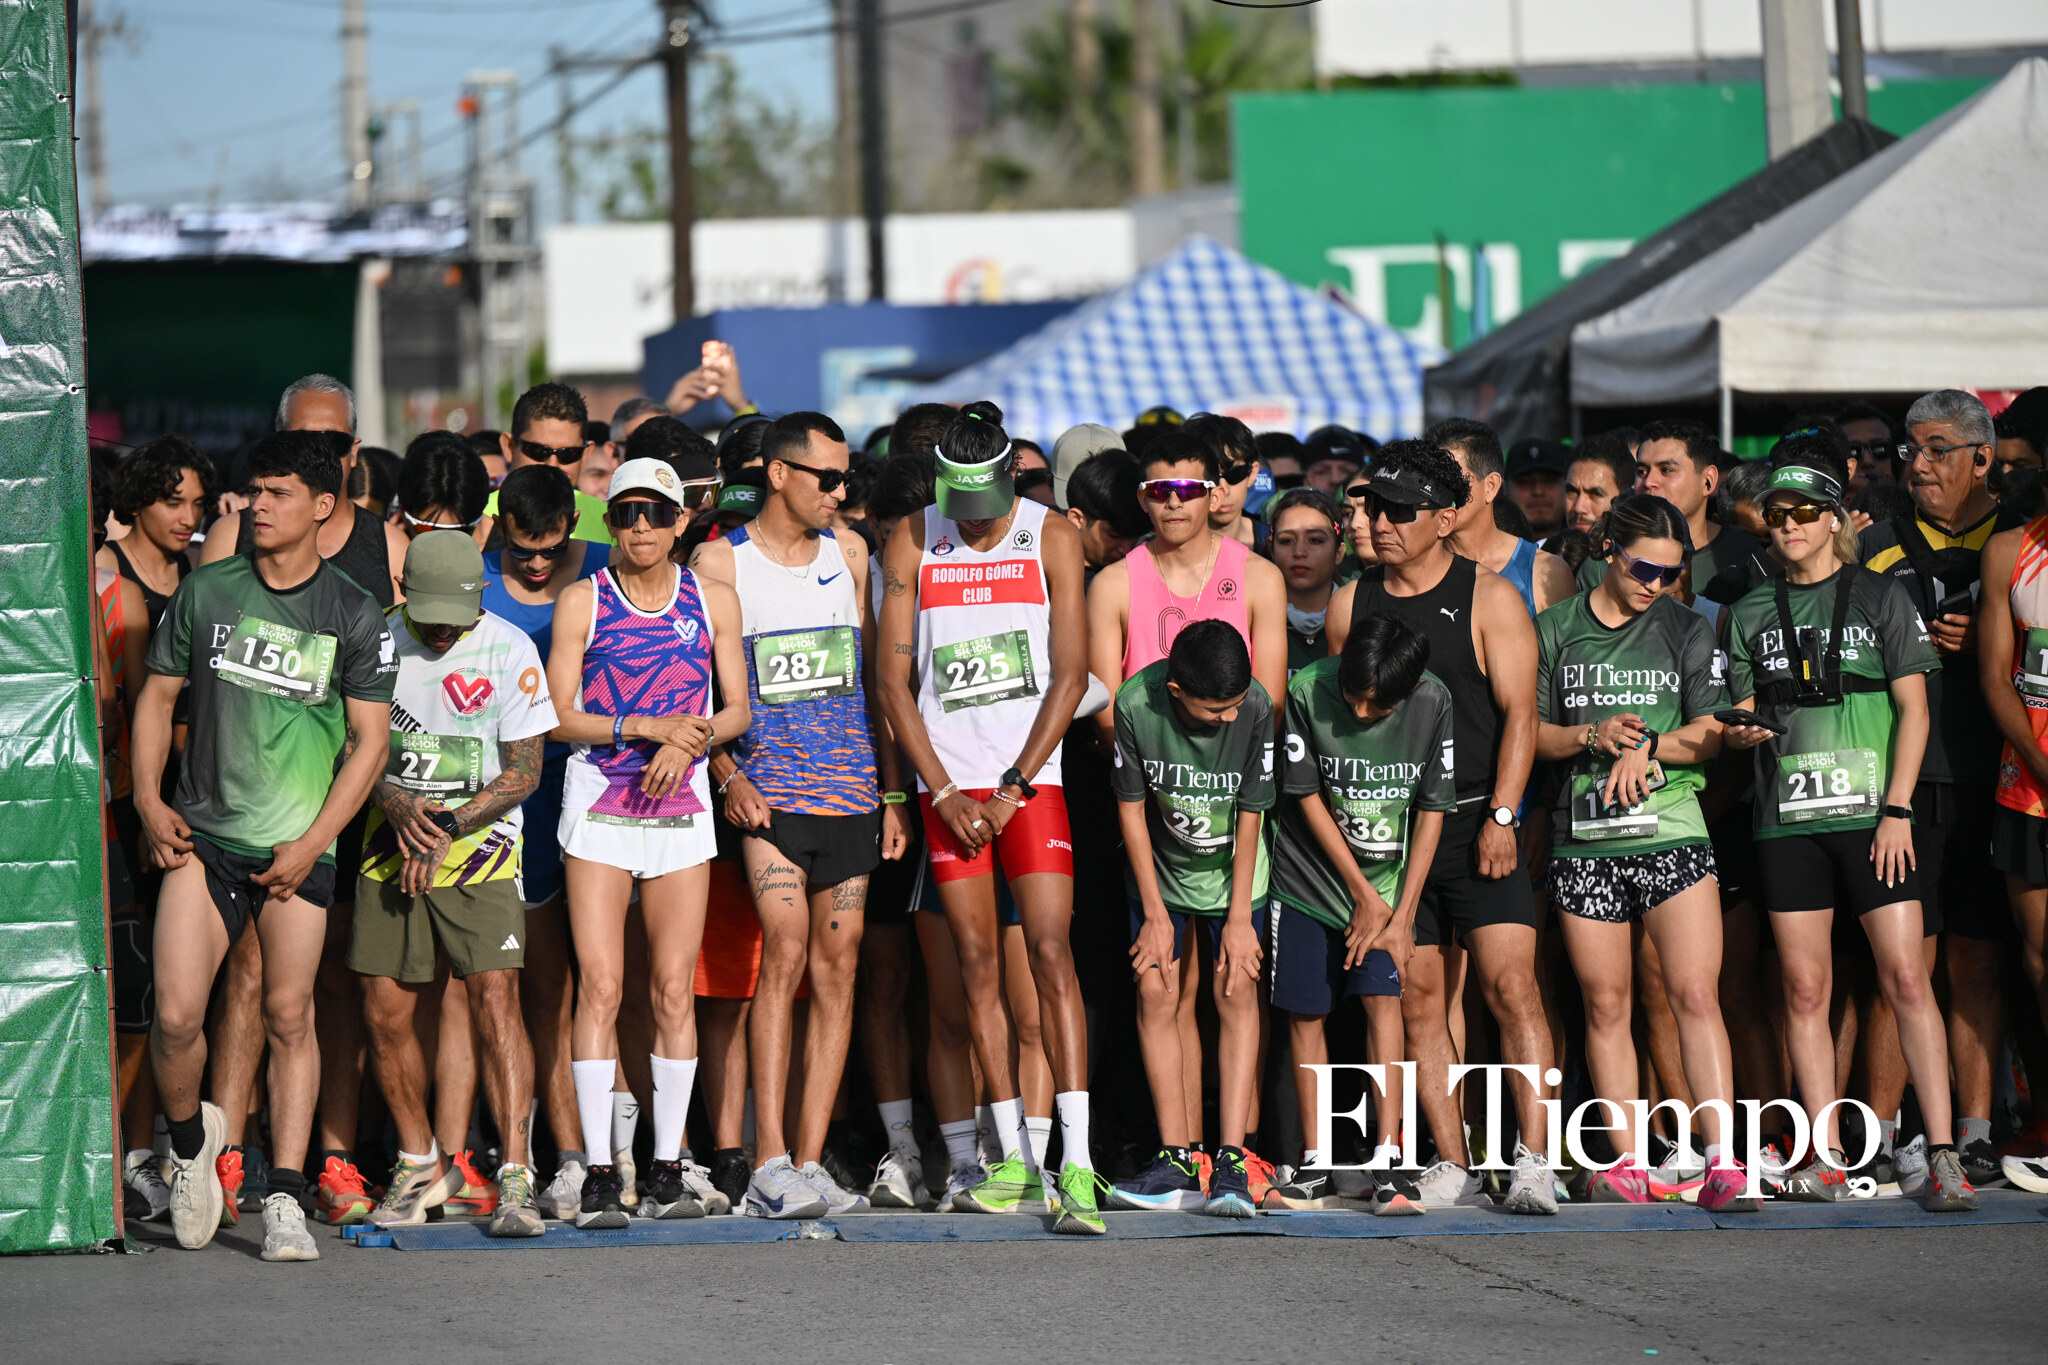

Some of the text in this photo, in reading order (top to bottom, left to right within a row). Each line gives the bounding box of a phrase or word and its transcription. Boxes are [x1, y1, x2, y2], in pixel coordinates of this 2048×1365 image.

[932, 563, 1025, 584] RODOLFO GÓMEZ
[963, 587, 992, 604] CLUB
[259, 621, 298, 637] CARRERA
[778, 633, 816, 642] CARRERA
[1761, 629, 1785, 656] El
[243, 636, 302, 678] 150
[321, 639, 335, 648] 150
[953, 638, 992, 650] CARRERA
[315, 651, 331, 697] MEDALLA
[769, 650, 830, 683] 287
[844, 643, 854, 687] MEDALLA
[946, 652, 1010, 690] 225
[1021, 645, 1034, 688] MEDALLA
[1562, 663, 1680, 692] El Tiempo
[1762, 657, 1790, 671] de
[1564, 690, 1658, 708] de todos
[402, 733, 440, 741] CARRERA
[400, 751, 442, 780] 27
[1318, 754, 1342, 781] El
[1797, 752, 1836, 760] CARRERA
[469, 751, 480, 792] MEDALLA
[1142, 759, 1165, 785] El
[1788, 768, 1852, 800] 218
[1867, 762, 1878, 806] MEDALLA
[1346, 786, 1410, 800] todos
[1172, 811, 1212, 838] 22
[1336, 808, 1393, 842] 236
[754, 862, 796, 880] Aurora
